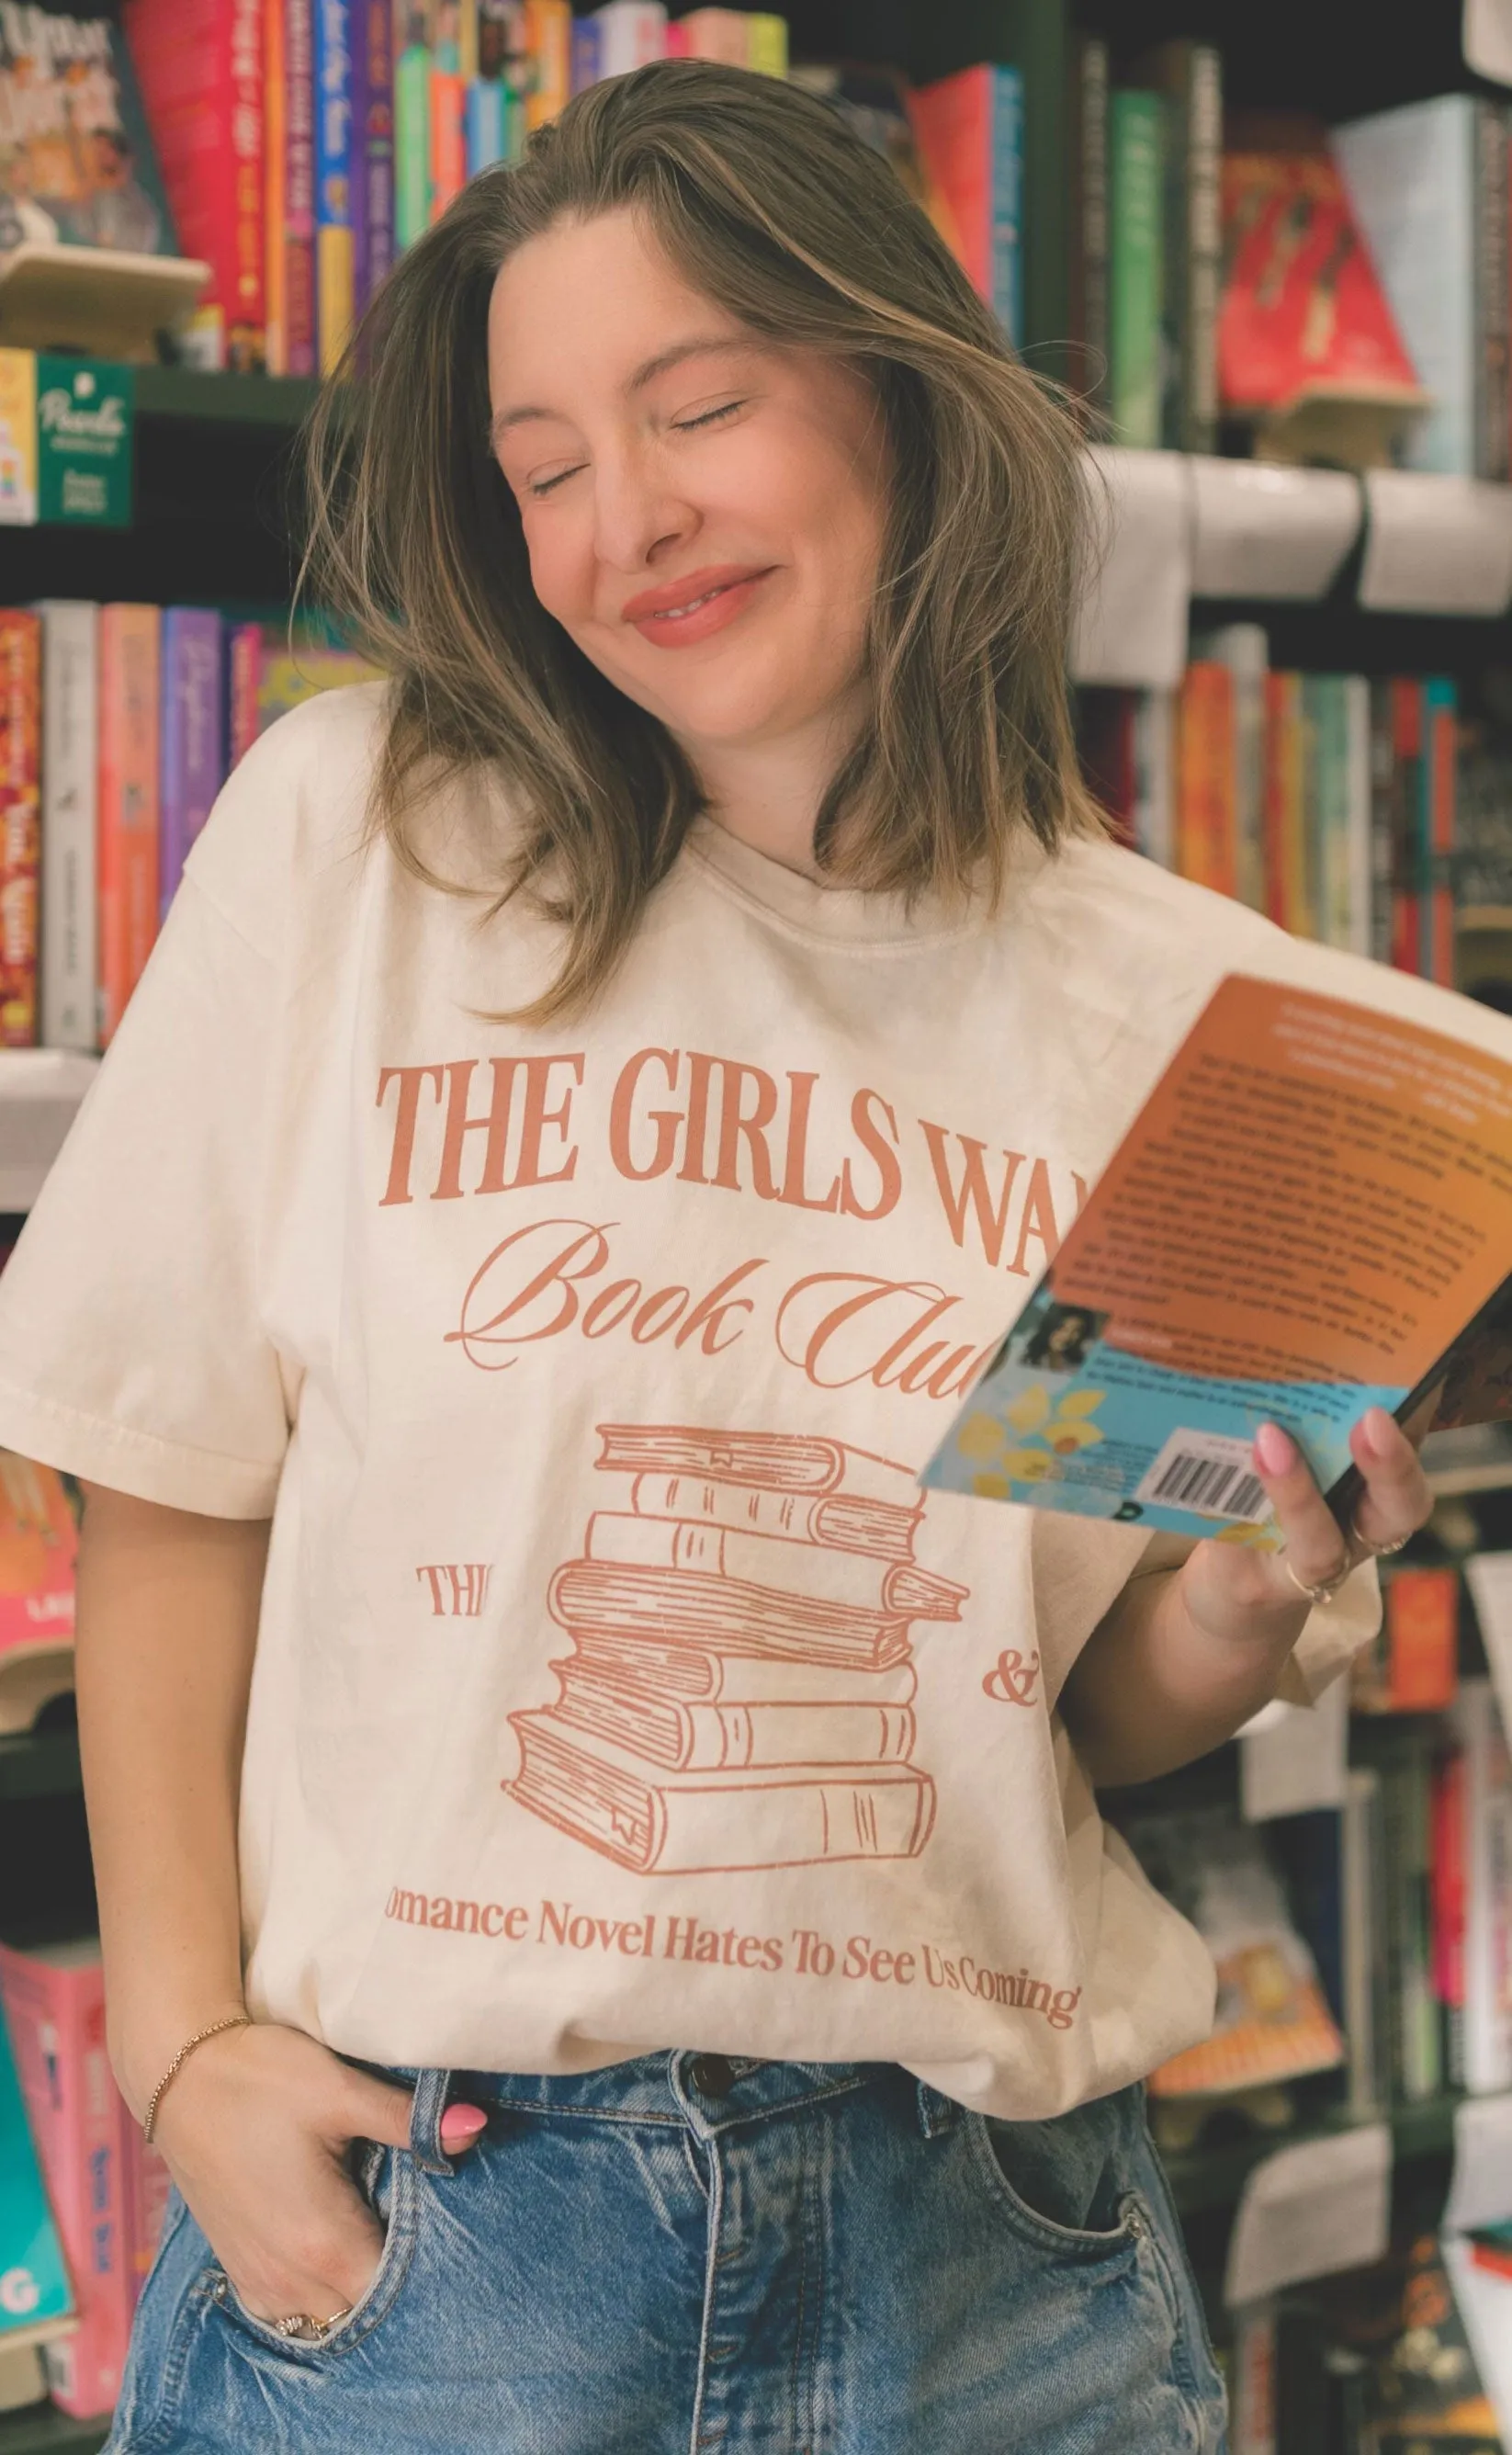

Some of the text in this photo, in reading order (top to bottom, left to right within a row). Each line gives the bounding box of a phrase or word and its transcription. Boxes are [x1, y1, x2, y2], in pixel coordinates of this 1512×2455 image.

[375, 1052, 585, 1207] THE
[609, 1046, 902, 1221] GIRLS
[918, 1118, 1089, 1277] WA
[444, 1218, 770, 1372] Book
[981, 1648, 1040, 1707] &
[536, 1900, 655, 1957] Novel
[662, 1914, 784, 1972] Hates
[792, 1929, 835, 1976] To
[841, 1935, 916, 1985] See
[921, 1944, 960, 1991] Us
[959, 1956, 1082, 2030] Coming
